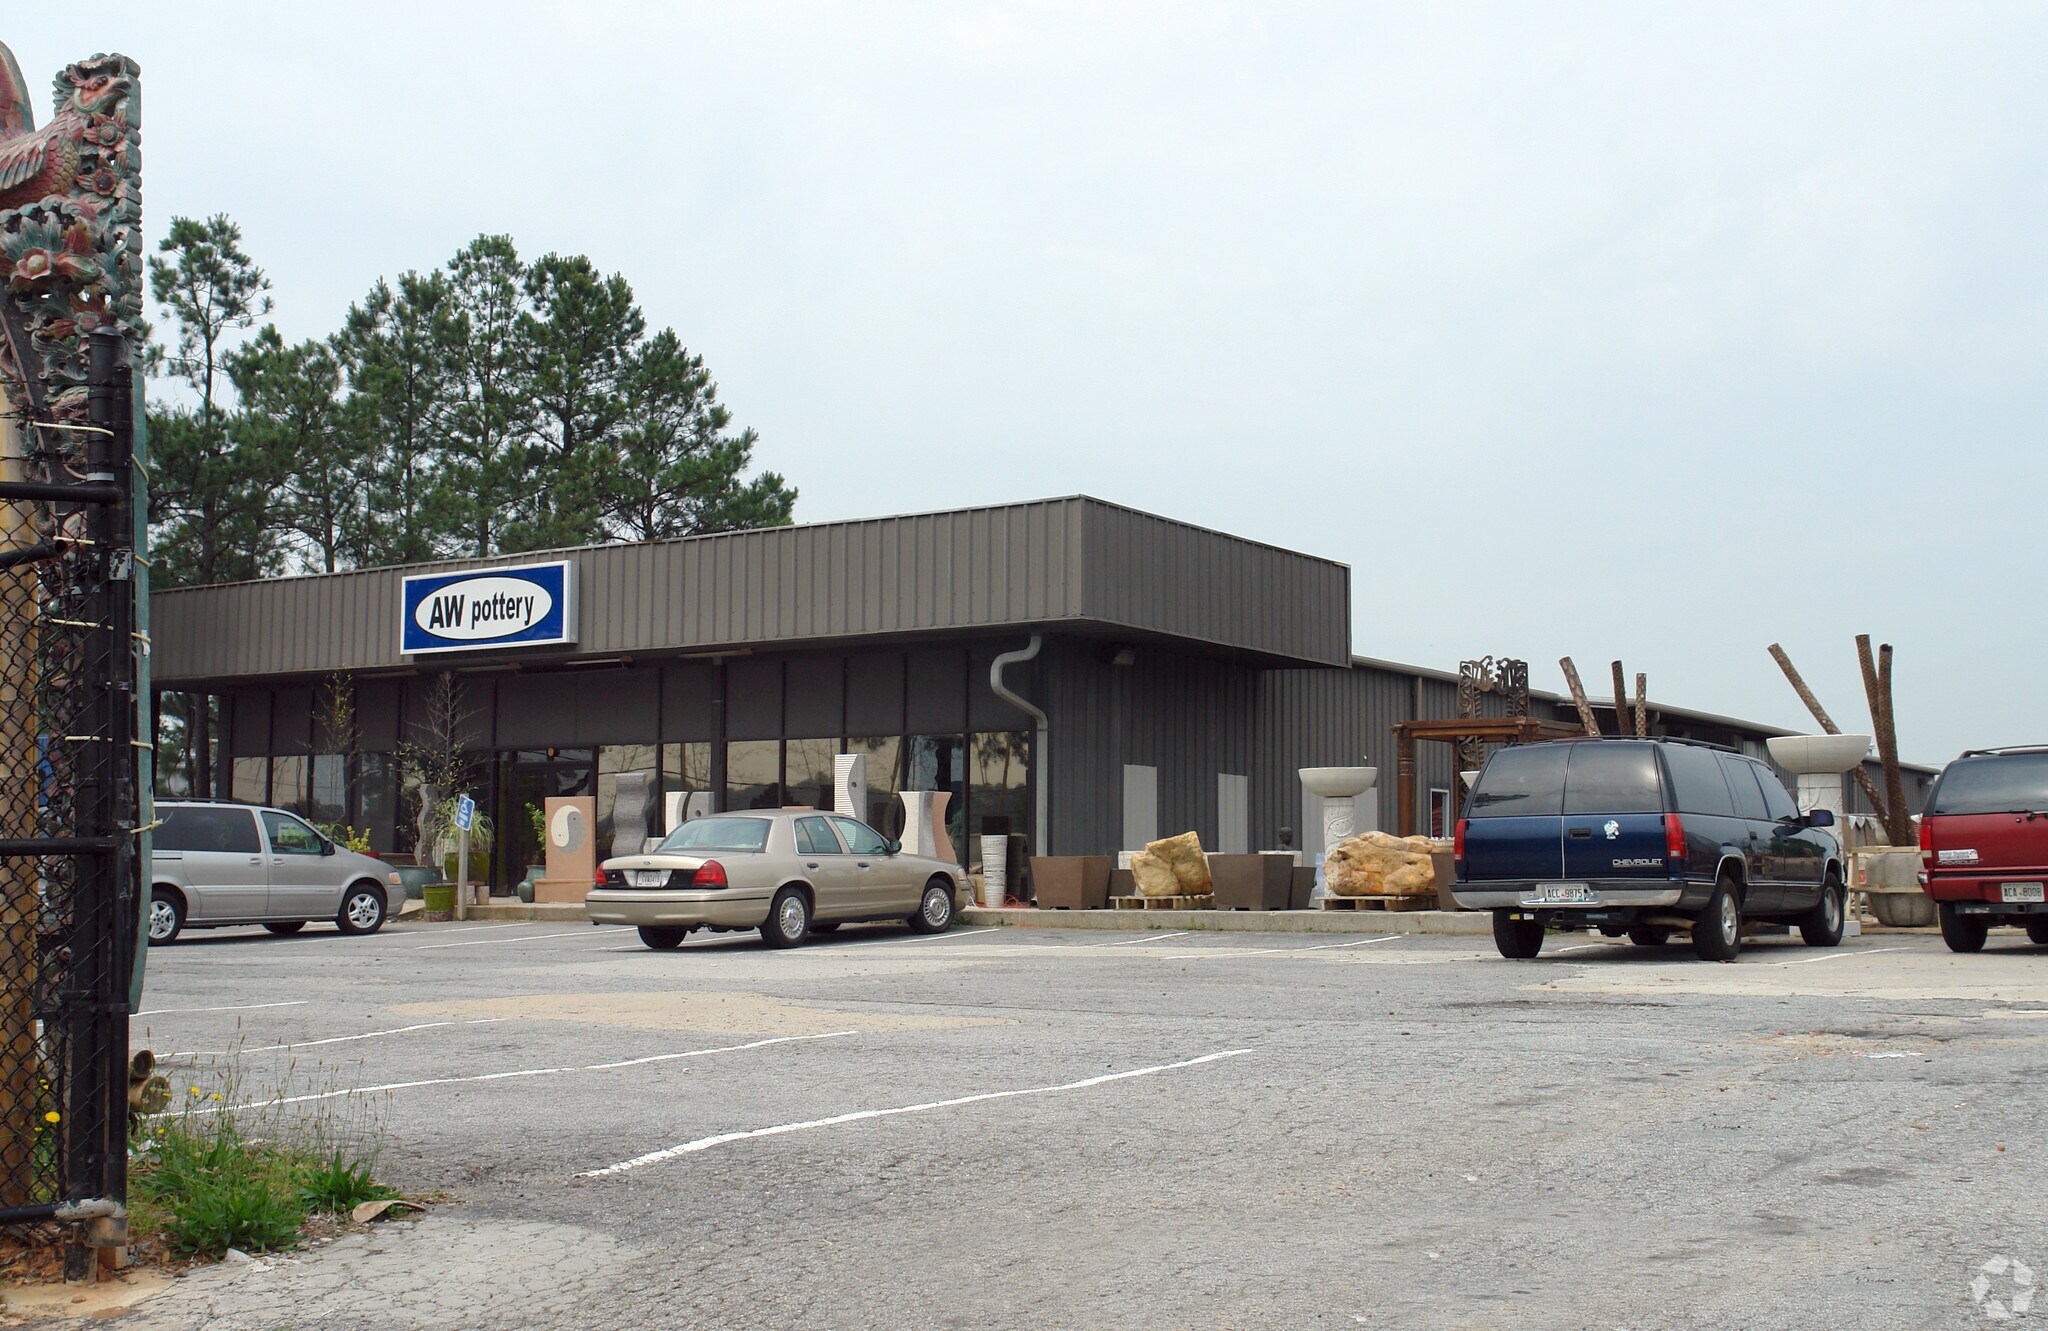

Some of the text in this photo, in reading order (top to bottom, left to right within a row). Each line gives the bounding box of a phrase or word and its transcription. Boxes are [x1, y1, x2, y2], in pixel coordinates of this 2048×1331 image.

[428, 591, 535, 630] AW pottery
[1612, 858, 1663, 866] CHEVROLET
